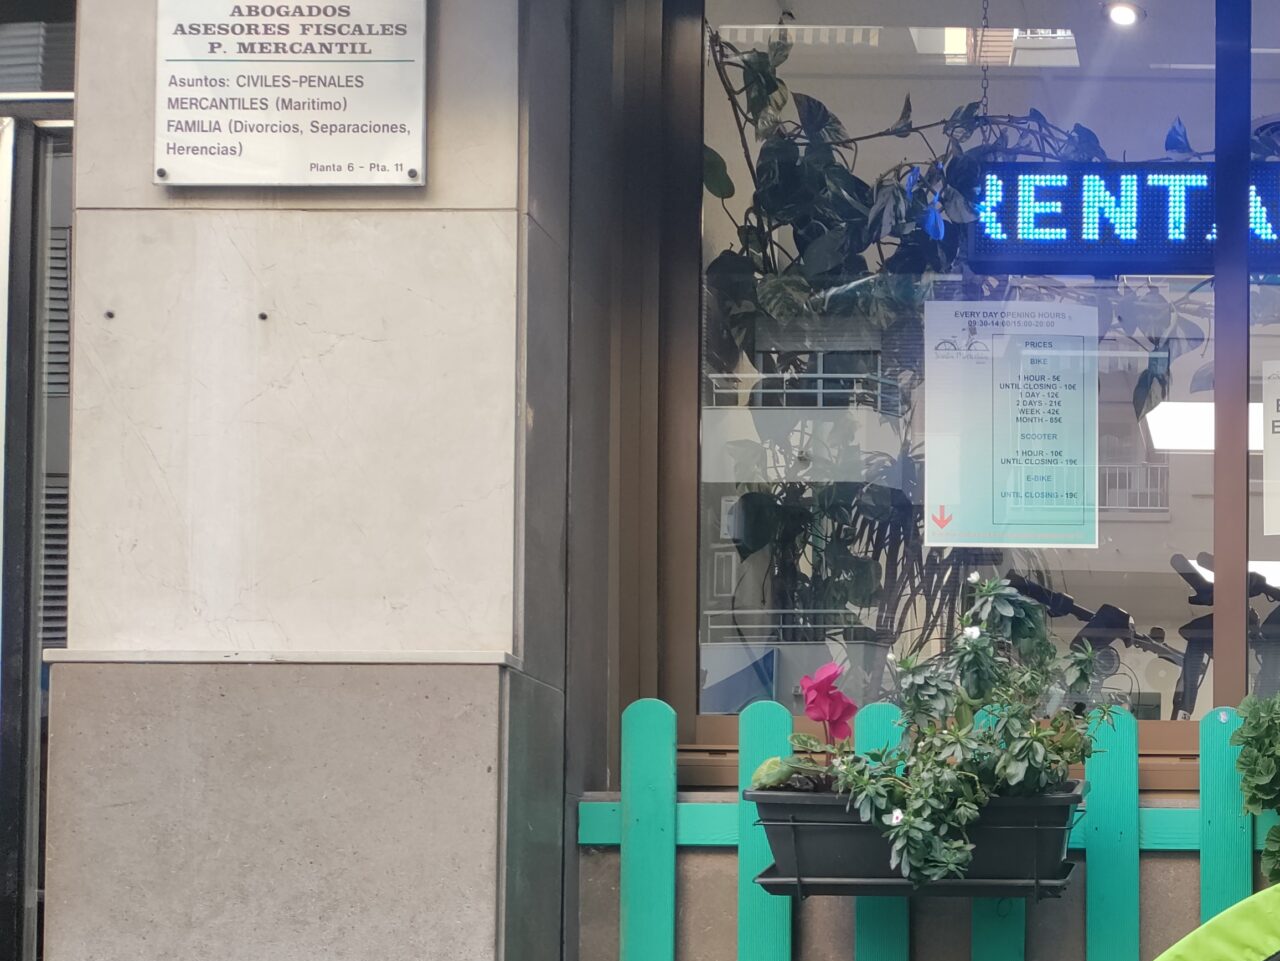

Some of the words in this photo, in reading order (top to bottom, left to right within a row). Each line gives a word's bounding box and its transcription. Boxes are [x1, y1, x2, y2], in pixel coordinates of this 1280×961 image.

[229, 5, 351, 18] ABOGADOS
[172, 23, 290, 36] ASESORES
[300, 23, 408, 36] FISCALES
[207, 41, 227, 55] P.
[236, 41, 372, 55] MERCANTIL
[168, 74, 230, 88] Asuntos:
[236, 74, 364, 88] CIVILES-PENALES
[167, 97, 269, 110] MERCANTILES
[275, 96, 348, 112] (Maritimo)
[166, 119, 222, 133] FAMILIA
[228, 119, 304, 135] (Divorcios,
[309, 120, 411, 136] Separaciones,
[166, 142, 243, 157] Herencias)
[309, 162, 342, 172] Planta
[347, 162, 354, 172] 6
[369, 162, 390, 172] Pta.
[394, 162, 403, 172] 11
[954, 311, 981, 319] EVERY
[982, 311, 999, 319] DAY
[1000, 311, 1036, 319] OPENING
[1024, 341, 1053, 349] PRICES
